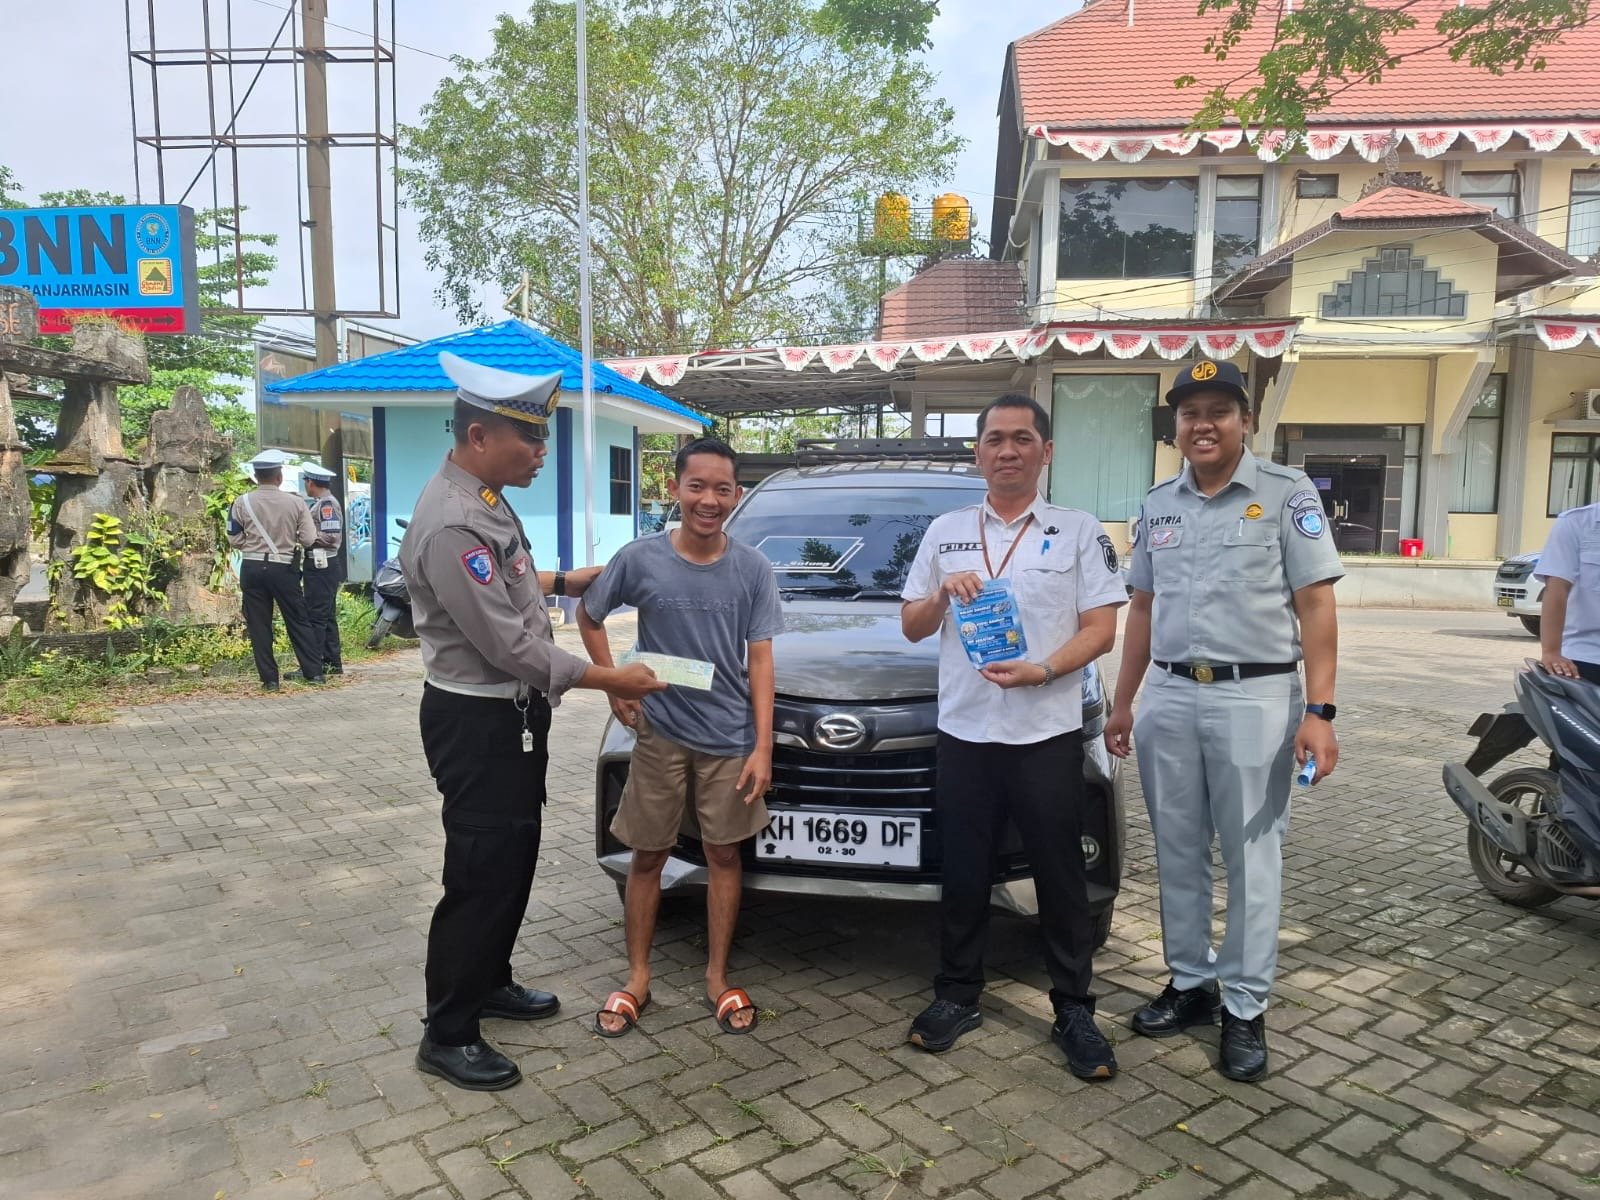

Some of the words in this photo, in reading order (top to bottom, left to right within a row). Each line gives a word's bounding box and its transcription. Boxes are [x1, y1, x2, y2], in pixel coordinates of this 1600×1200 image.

[1149, 515, 1182, 529] SATRIA
[761, 815, 794, 841] KH
[803, 817, 867, 846] 1669
[881, 821, 916, 847] DF
